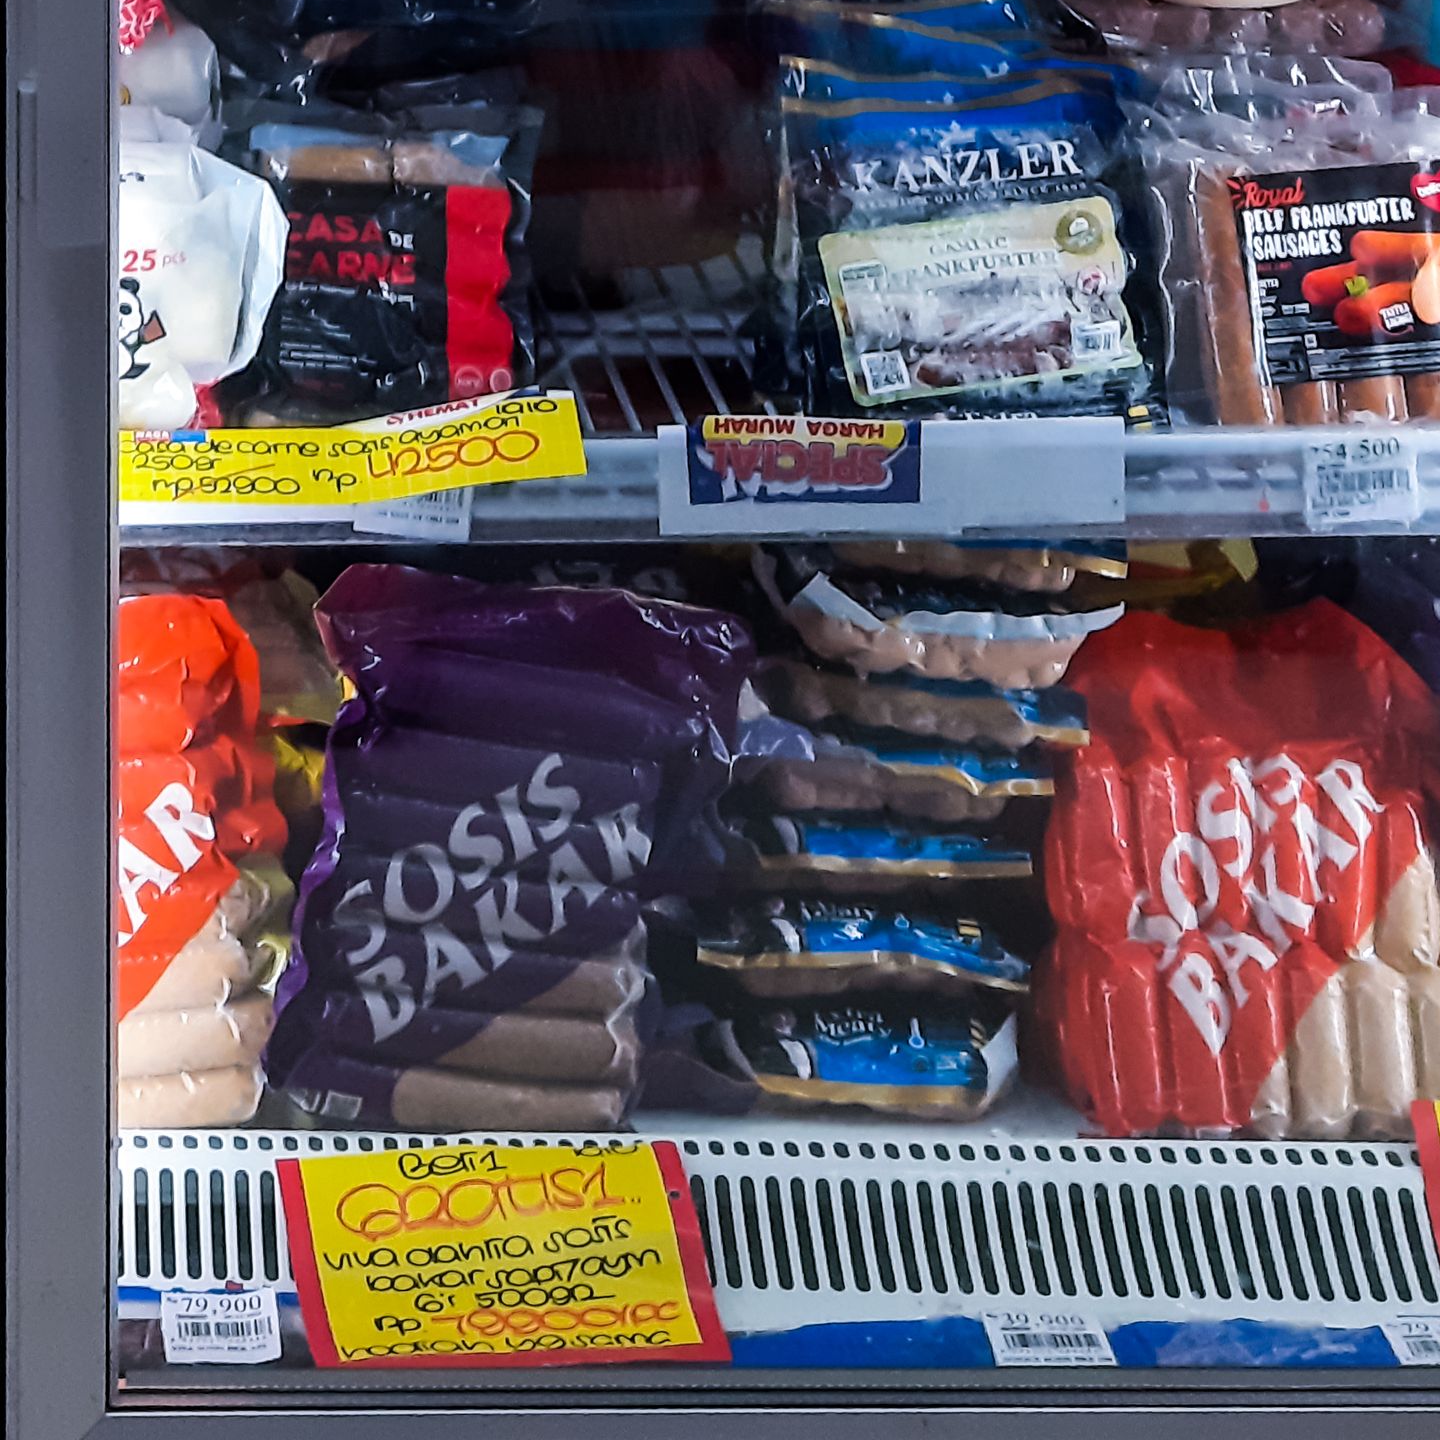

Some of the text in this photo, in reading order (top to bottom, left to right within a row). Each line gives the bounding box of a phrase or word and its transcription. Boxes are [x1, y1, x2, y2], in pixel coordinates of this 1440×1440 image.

[850, 139, 1081, 195] KANZLER
[1244, 178, 1305, 206] Royal
[1289, 197, 1417, 230] FRANKFURTER
[388, 230, 414, 250] DE
[1252, 229, 1343, 261] SAUSAGES
[122, 249, 187, 272] 25 pcs
[706, 439, 889, 486] SPECIAL
[332, 752, 583, 966] SOSIS
[355, 802, 652, 1044] BAKAR
[1167, 758, 1387, 1058] BAKAR
[181, 1293, 263, 1315] 79,900
